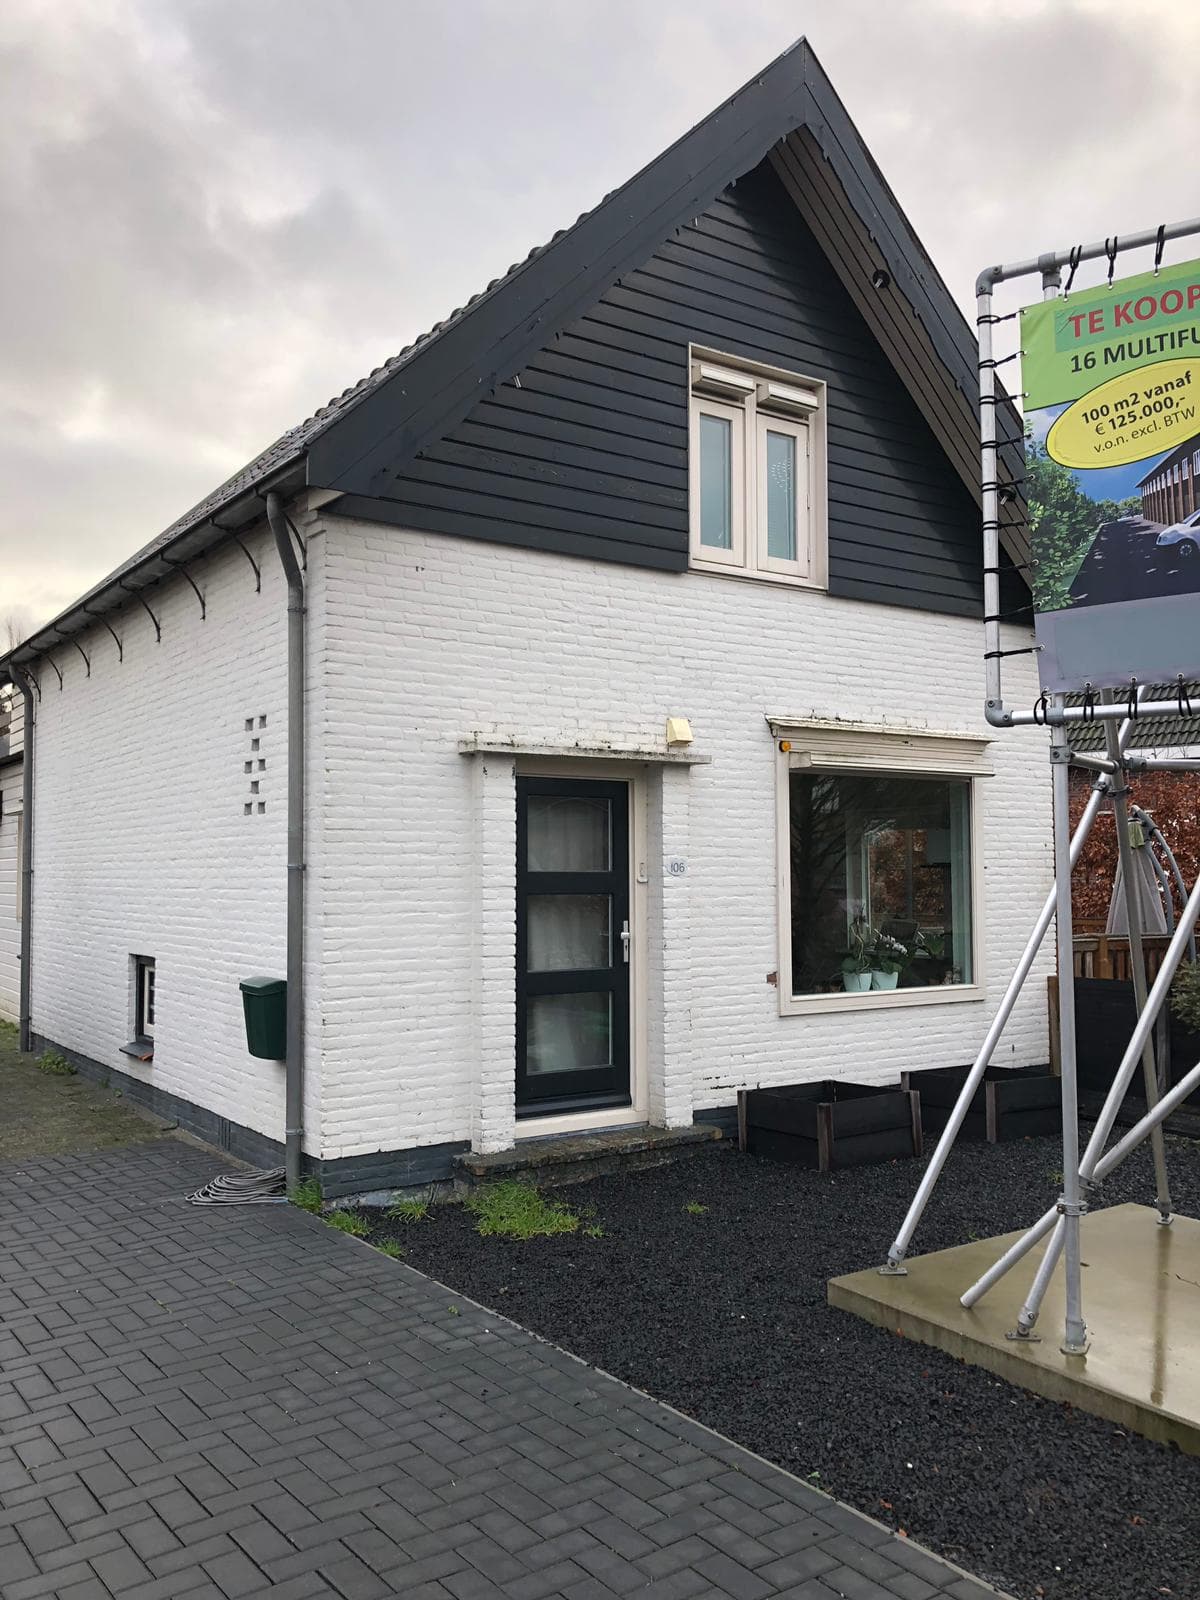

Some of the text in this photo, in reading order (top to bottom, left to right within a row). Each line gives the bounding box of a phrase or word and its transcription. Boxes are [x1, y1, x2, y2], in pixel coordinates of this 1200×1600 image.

[1070, 284, 1200, 338] TE KOOP
[1070, 351, 1096, 373] 16
[1081, 370, 1191, 424] 100 m2 vanaf
[1095, 396, 1186, 436] € 125.000,-
[1093, 406, 1195, 453] v.o.n. excl. BTW
[670, 862, 685, 873] 106
